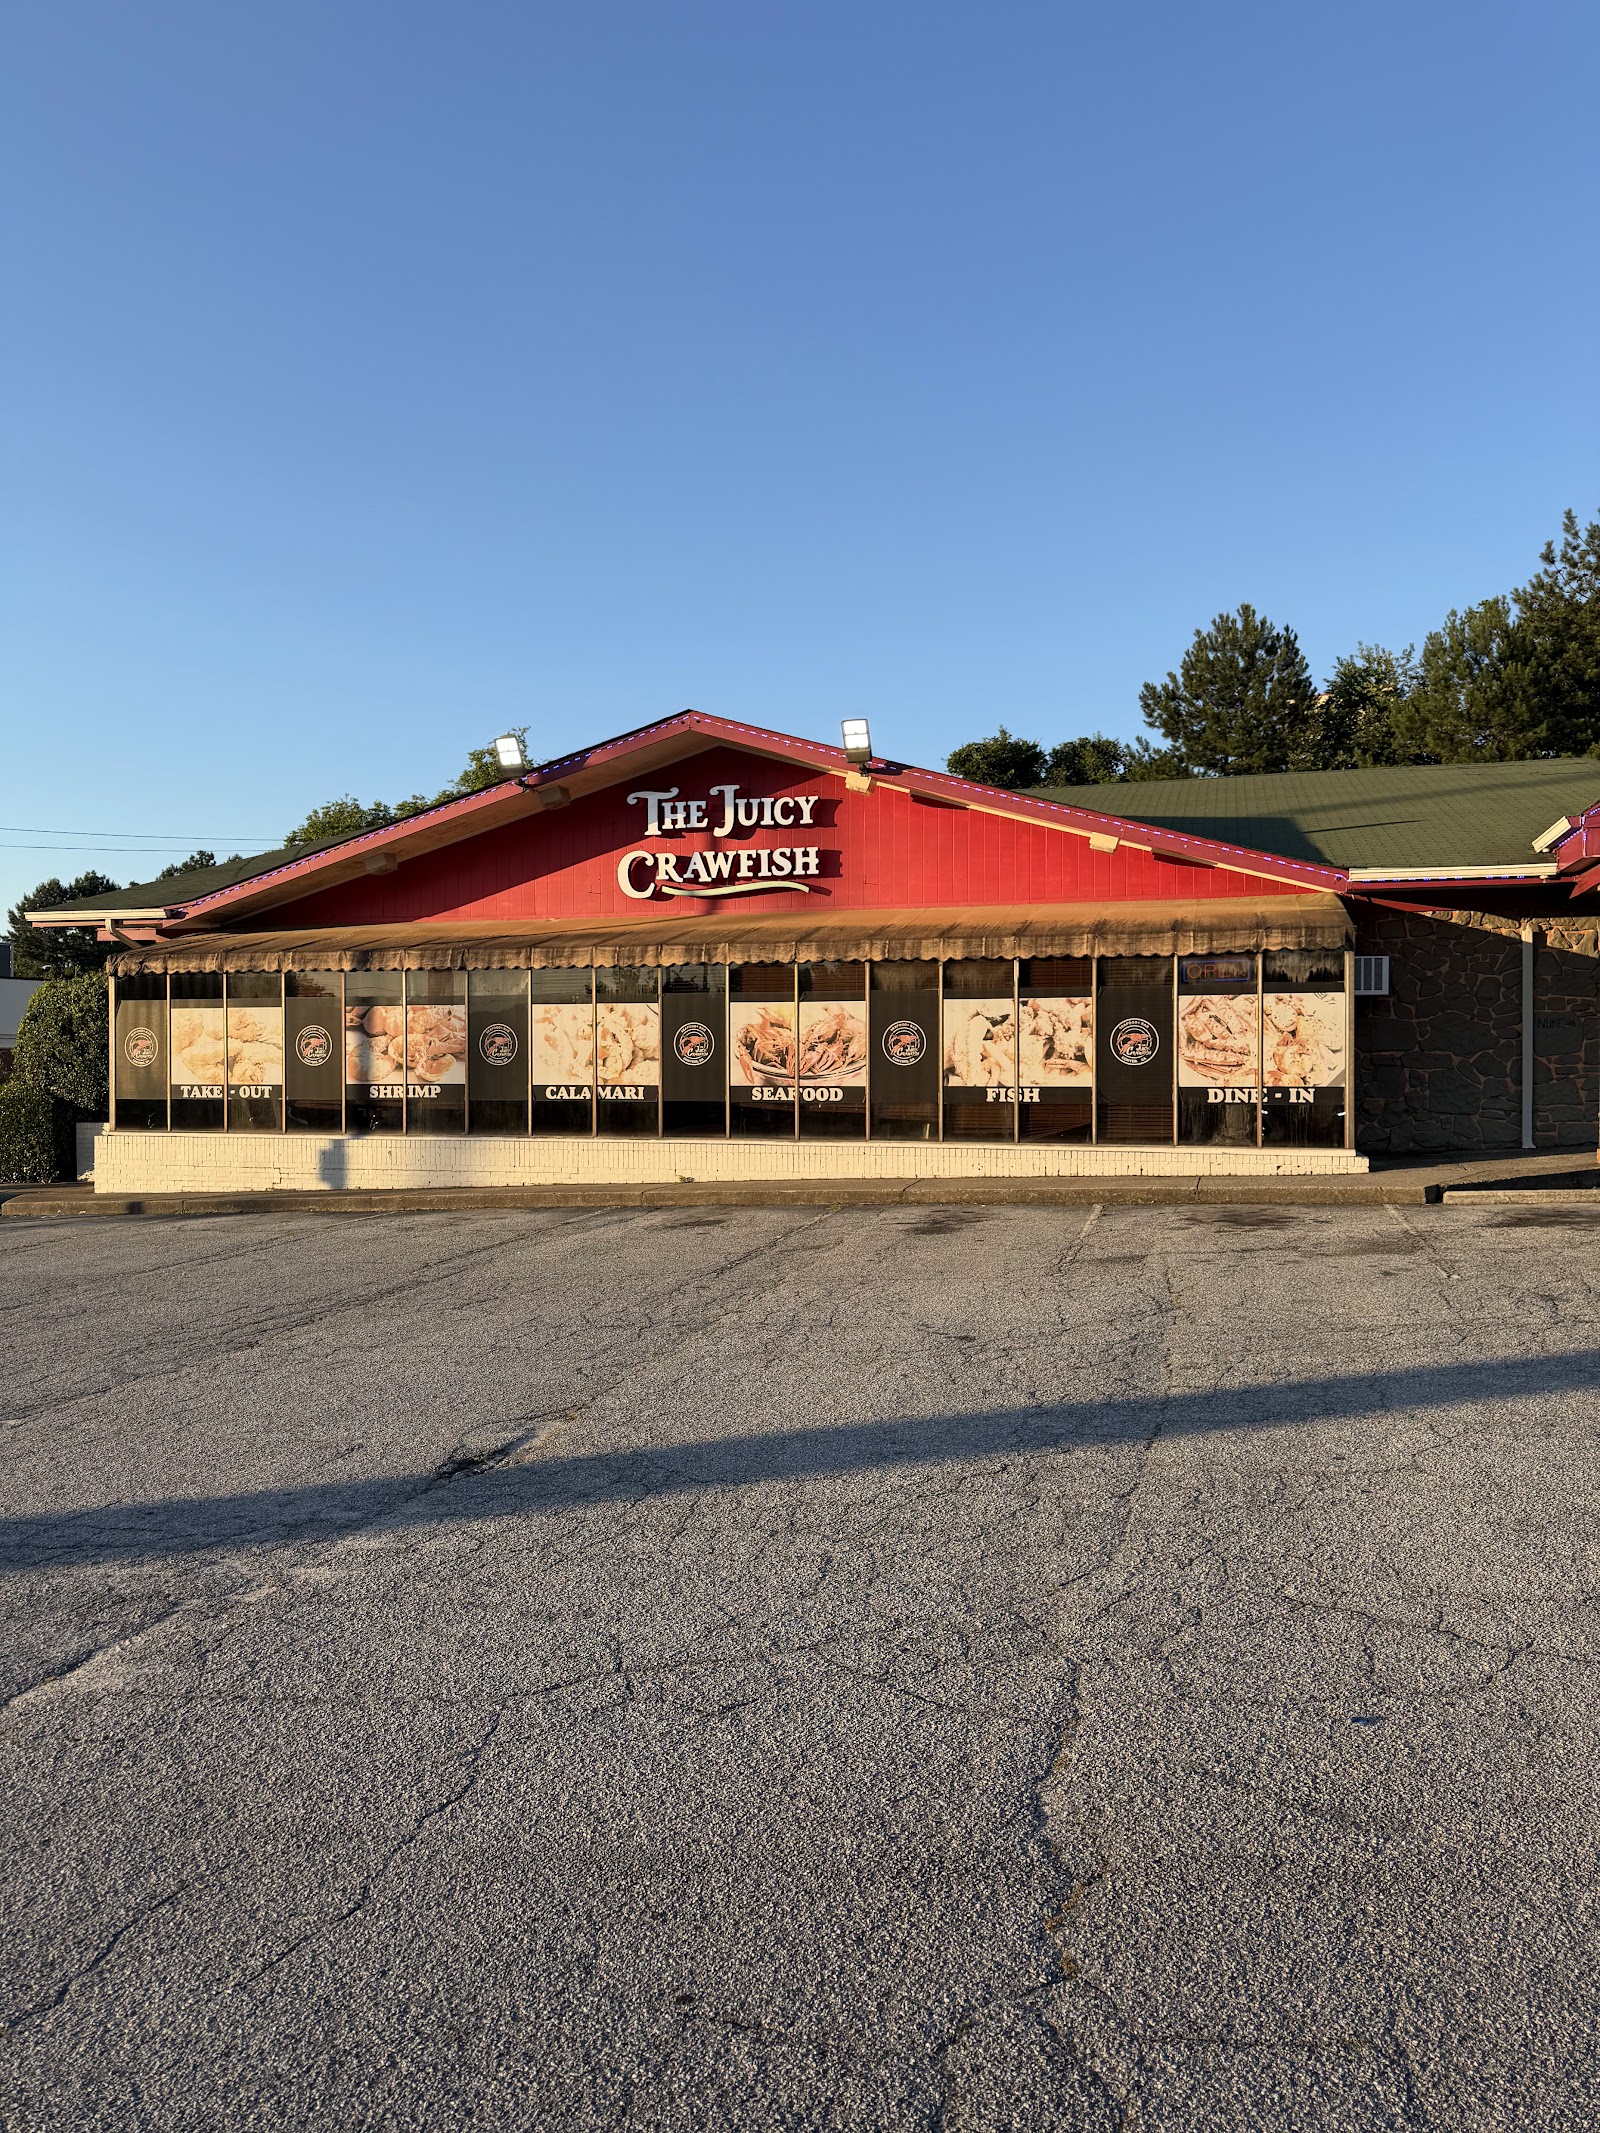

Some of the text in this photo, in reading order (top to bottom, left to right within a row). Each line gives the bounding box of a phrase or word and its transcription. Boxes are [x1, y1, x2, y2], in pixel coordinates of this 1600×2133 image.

[626, 784, 819, 837] THE JUICY
[617, 846, 820, 899] CRAWFISH
[1537, 1018, 1563, 1029] NUKE
[180, 1085, 223, 1098] TAKE
[239, 1085, 272, 1098] OUT
[369, 1085, 441, 1098] SHRIMP
[545, 1086, 644, 1100] CALAMARI
[751, 1087, 844, 1102] SEAFOOD
[985, 1088, 1041, 1103] FISH
[1207, 1088, 1268, 1103] DINE
[1289, 1088, 1316, 1103] IN
